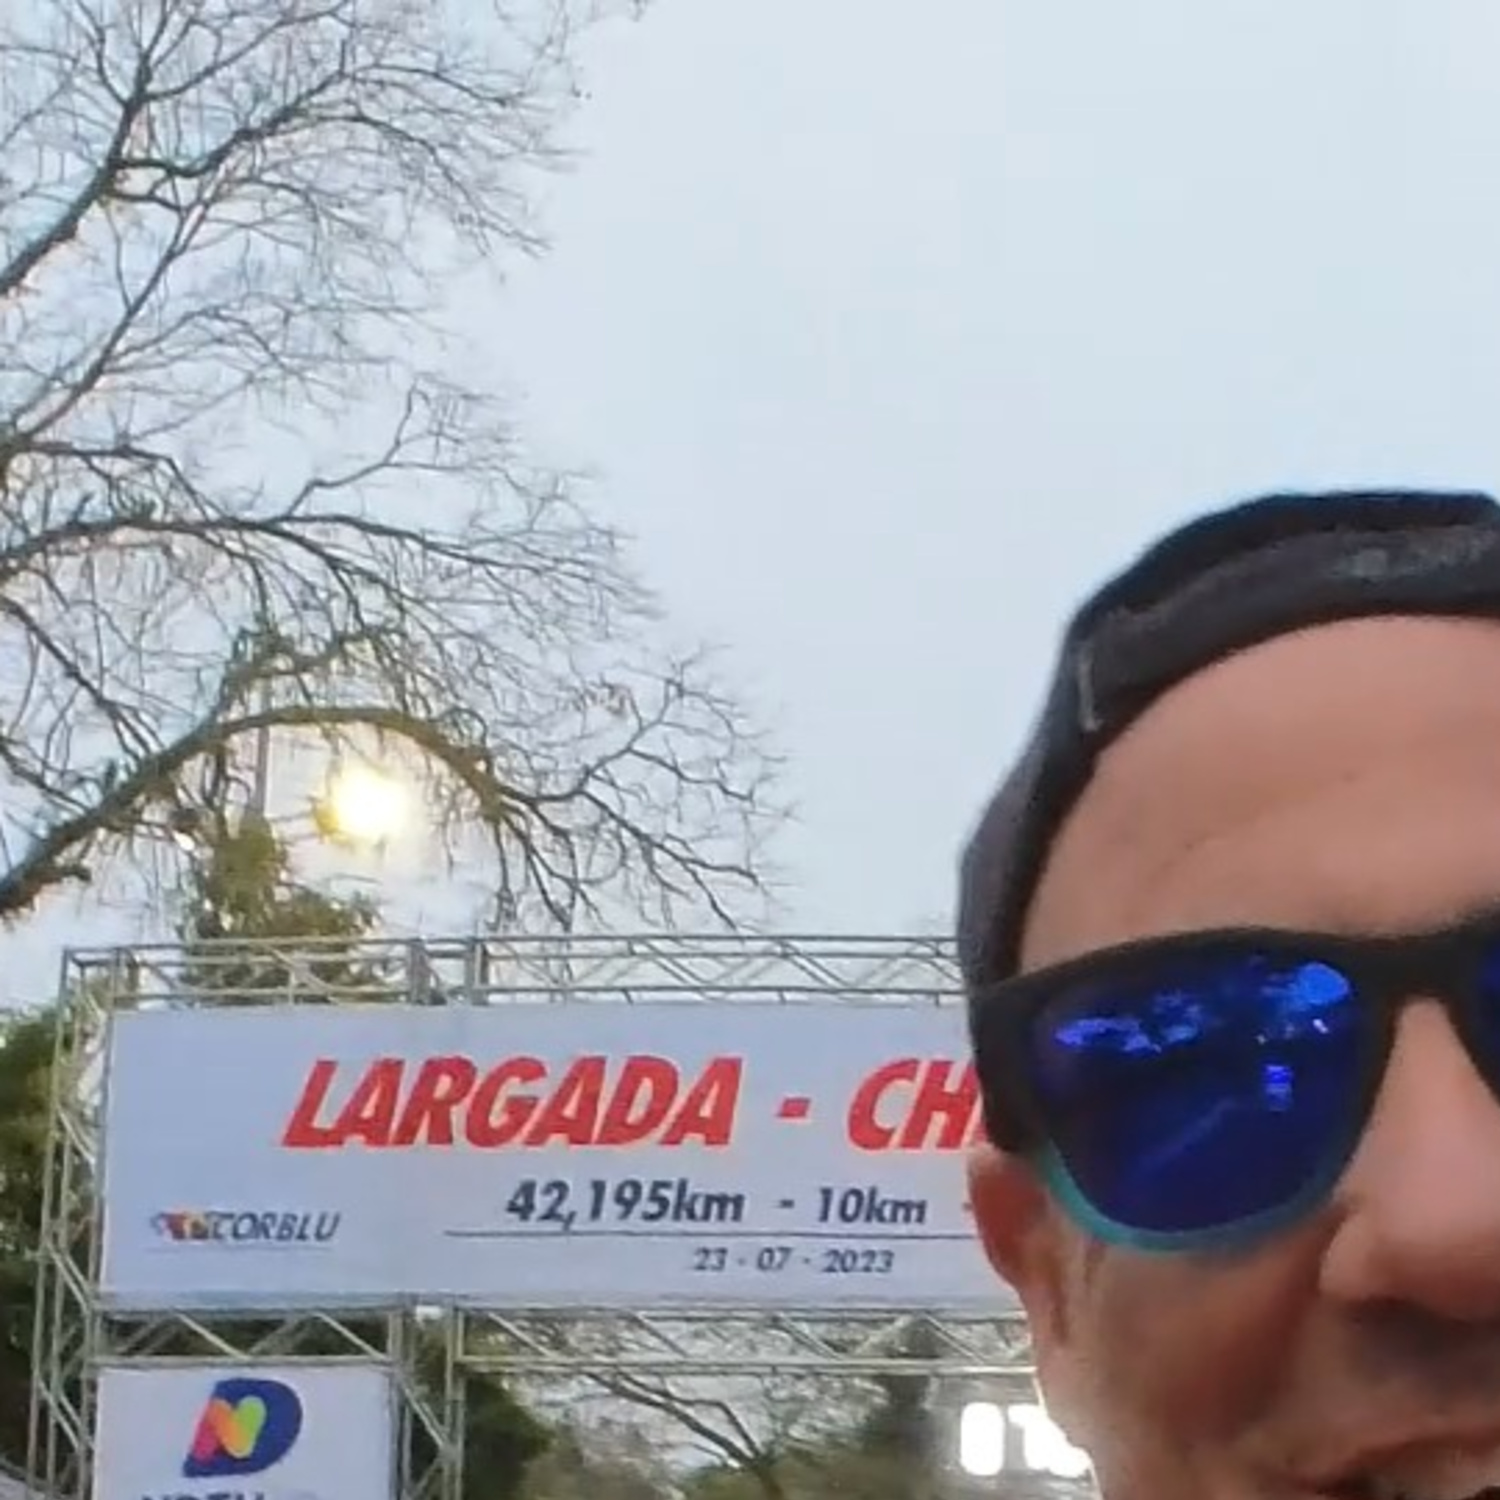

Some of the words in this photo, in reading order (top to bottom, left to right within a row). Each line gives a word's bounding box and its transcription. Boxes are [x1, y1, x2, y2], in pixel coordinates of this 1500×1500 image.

[283, 1055, 743, 1148] LARGADA
[847, 1057, 987, 1150] CH
[506, 1178, 745, 1230] 42,195km
[817, 1187, 927, 1225] 10km
[822, 1247, 896, 1273] 2023
